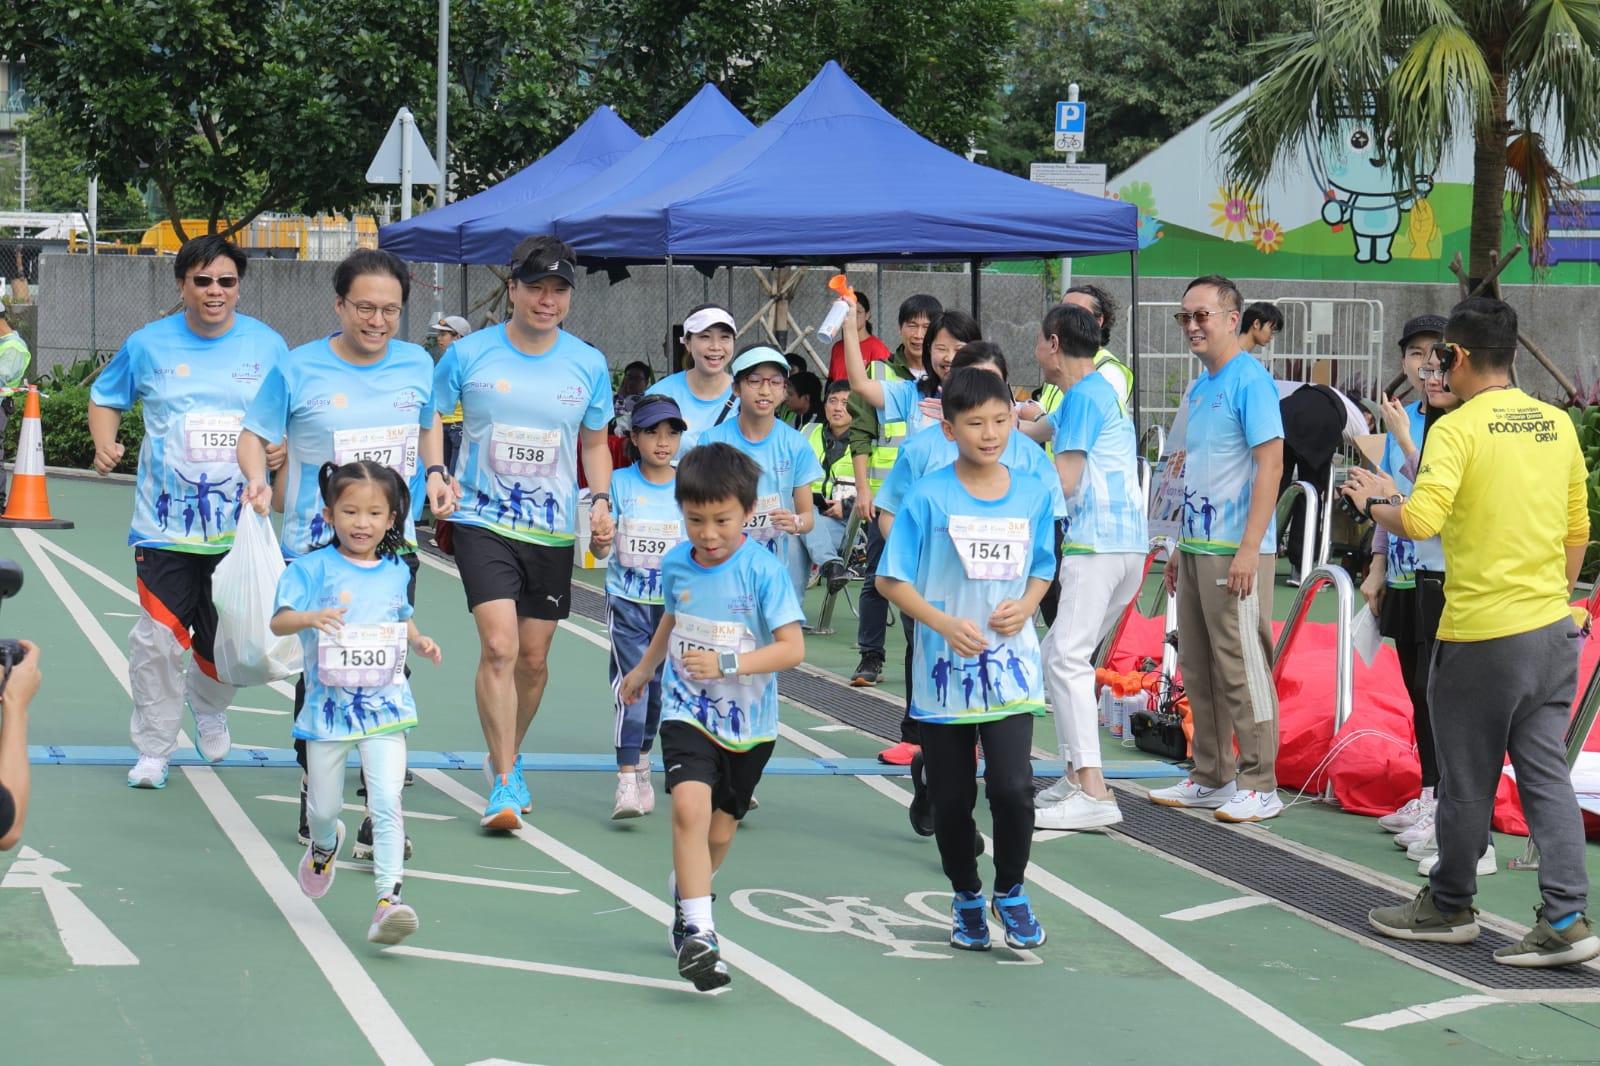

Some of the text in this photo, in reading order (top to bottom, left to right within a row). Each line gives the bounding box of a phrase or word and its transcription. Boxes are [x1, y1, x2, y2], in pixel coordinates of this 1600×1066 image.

[1061, 105, 1080, 129] P
[1488, 420, 1555, 435] FOODSPORT
[201, 432, 238, 448] 1525
[1535, 432, 1558, 443] CREW
[406, 445, 416, 468] 1527
[507, 445, 545, 462] 1538
[743, 514, 767, 529] 37
[629, 538, 666, 554] 1539
[969, 541, 1011, 560] 1541
[340, 648, 387, 667] 1530
